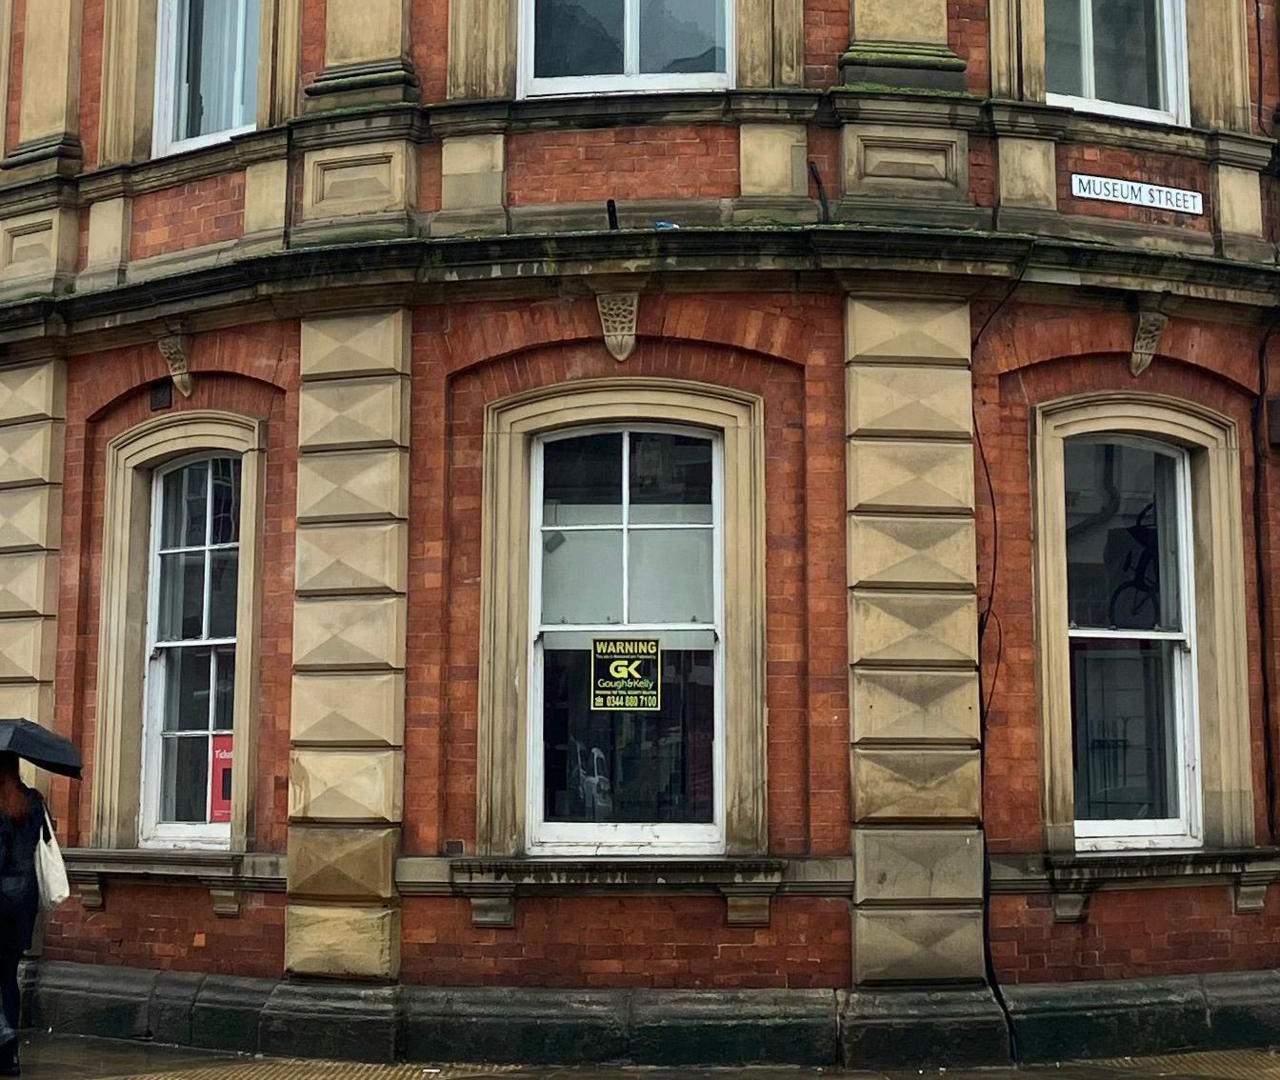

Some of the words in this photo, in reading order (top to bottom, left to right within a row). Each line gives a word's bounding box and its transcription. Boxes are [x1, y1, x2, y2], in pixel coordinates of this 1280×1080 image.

[1078, 178, 1142, 201] MUSEUM
[1148, 188, 1198, 210] STREET
[596, 641, 657, 654] WARNING
[609, 660, 642, 679] GK
